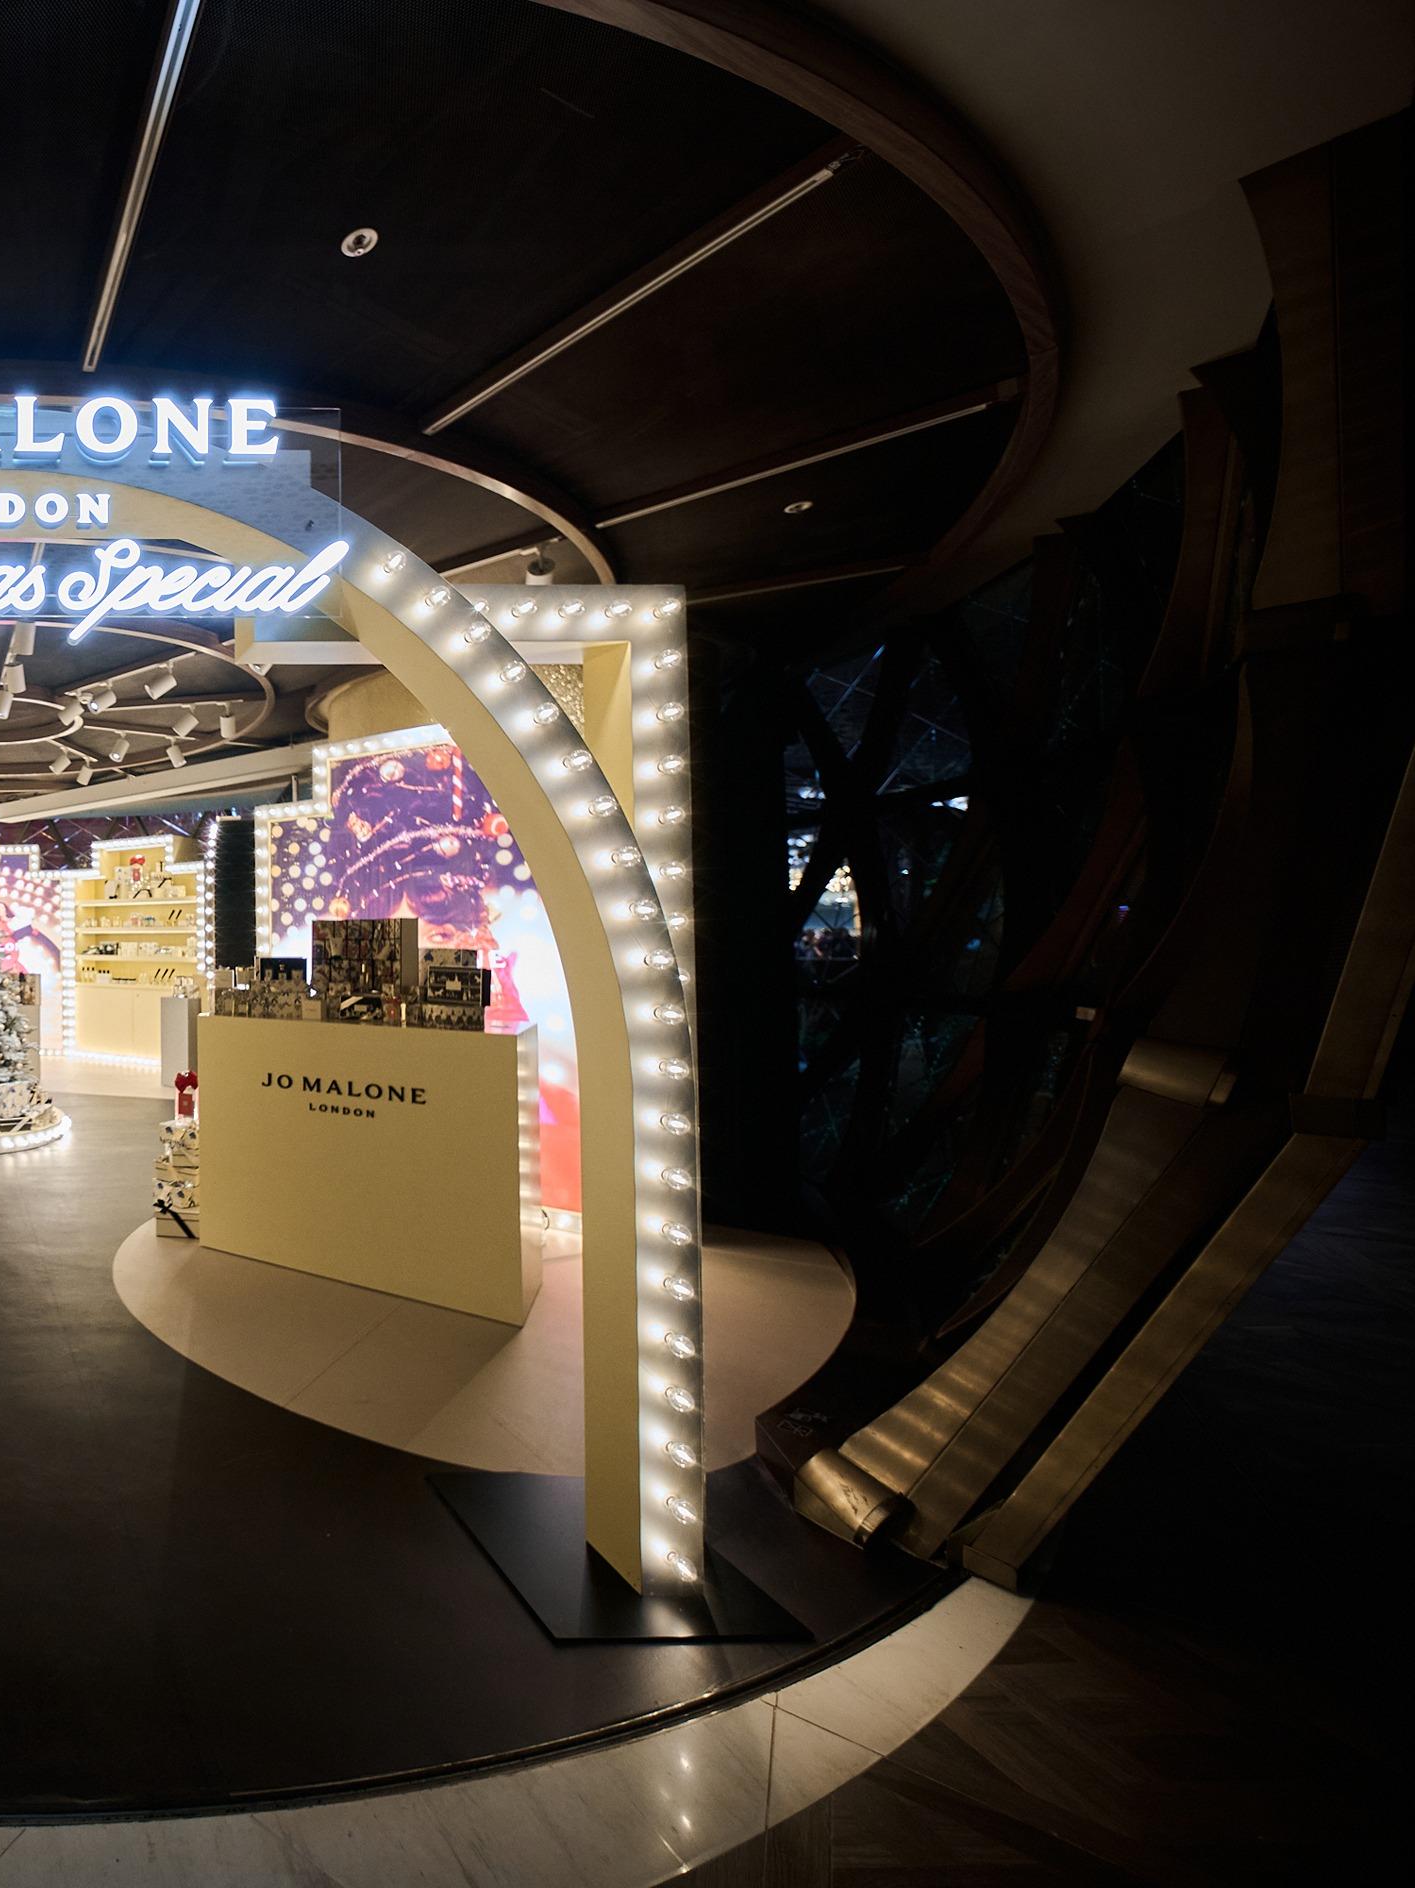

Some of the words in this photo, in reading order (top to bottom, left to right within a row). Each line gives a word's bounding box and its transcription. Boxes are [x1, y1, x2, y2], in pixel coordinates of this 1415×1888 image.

[58, 538, 350, 645] Special
[261, 1072, 294, 1090] JO
[302, 1076, 427, 1105] MALONE
[308, 1102, 376, 1118] LONDON
